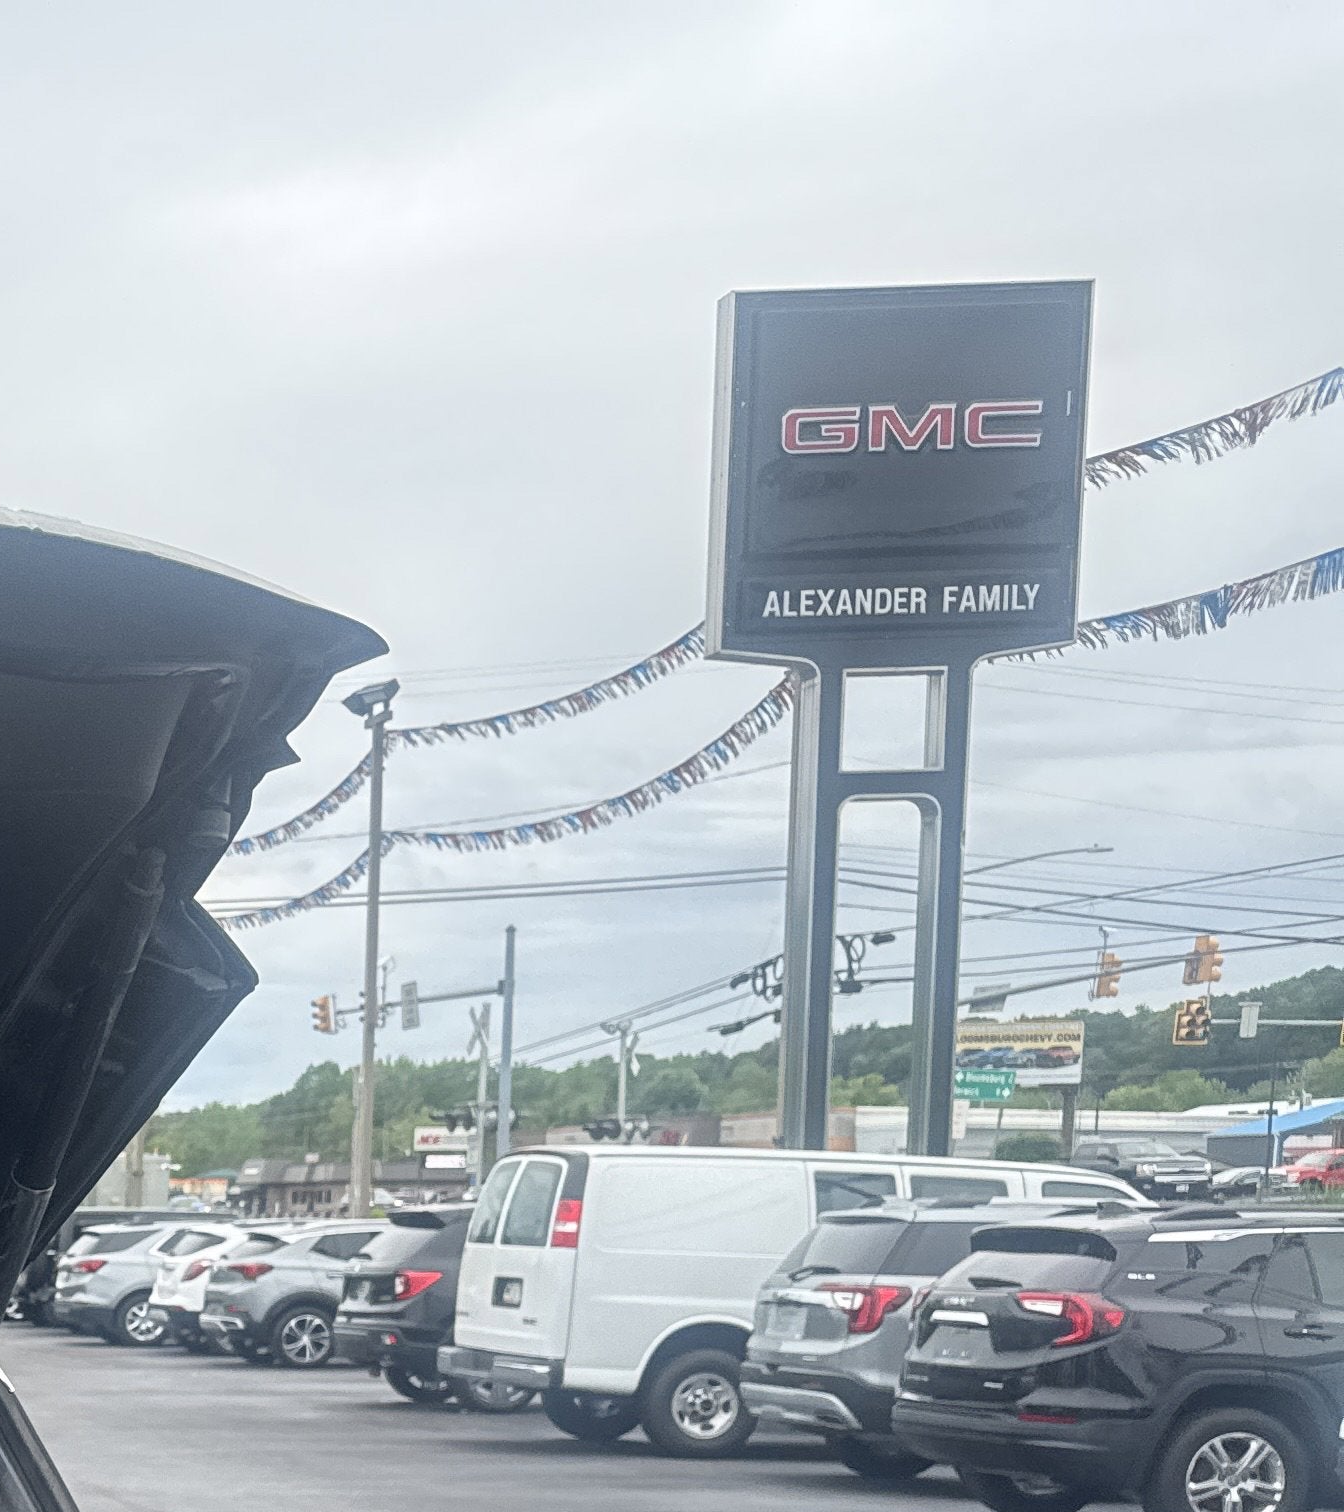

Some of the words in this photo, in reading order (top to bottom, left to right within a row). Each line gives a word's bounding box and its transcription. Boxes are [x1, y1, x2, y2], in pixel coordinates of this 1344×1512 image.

[782, 400, 1043, 454] GMC
[762, 588, 927, 617] ALEXANDER
[942, 584, 1040, 613] FAMILY
